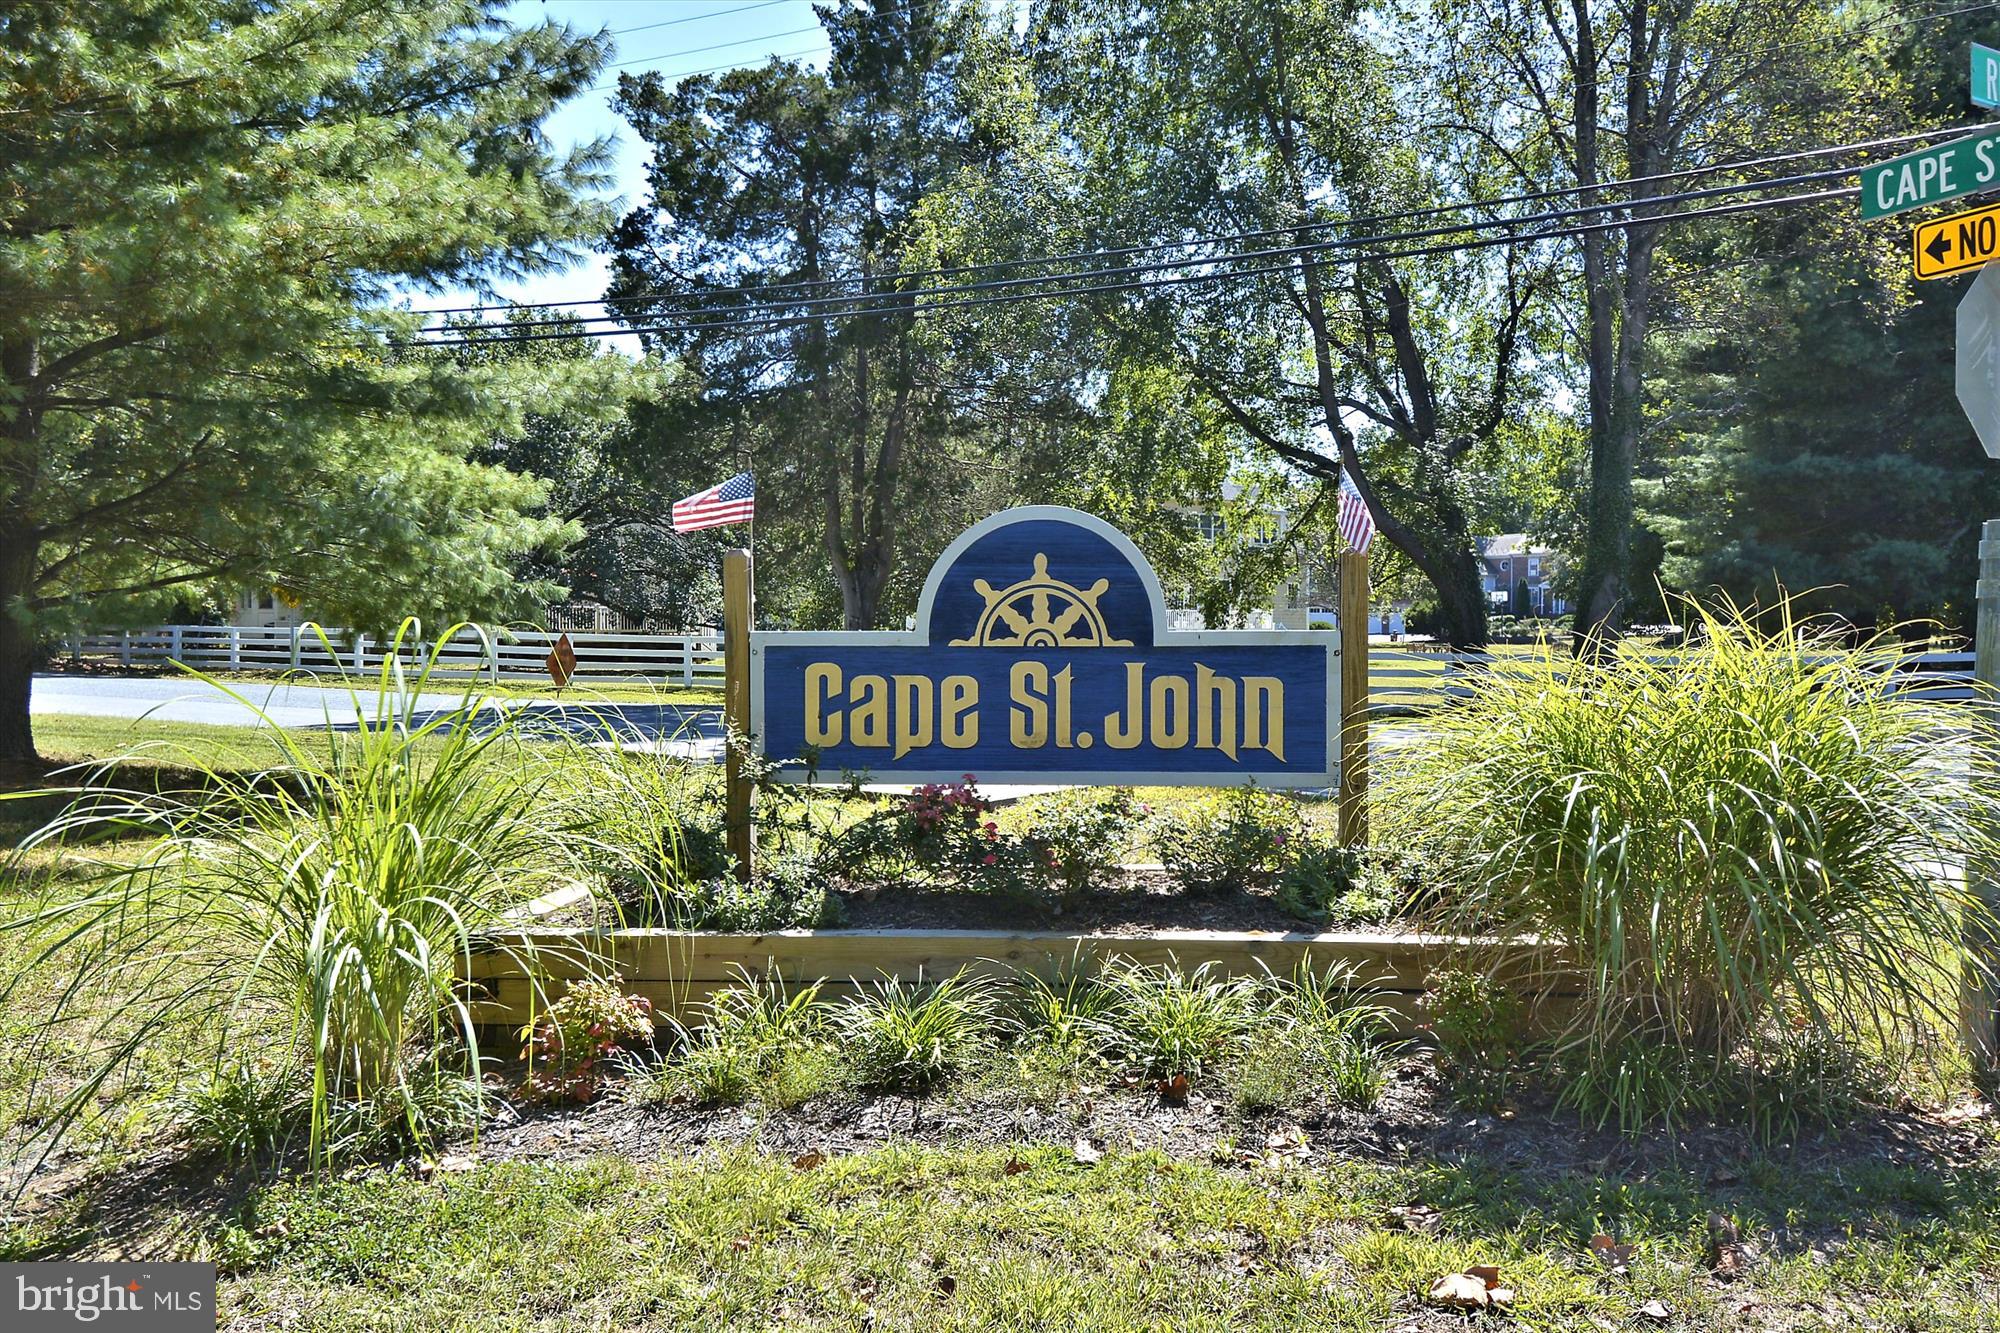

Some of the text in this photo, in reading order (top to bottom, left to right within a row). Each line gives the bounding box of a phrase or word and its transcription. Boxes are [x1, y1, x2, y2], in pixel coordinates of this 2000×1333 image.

[1877, 150, 1957, 210] CAPE
[1959, 216, 1996, 261] NO
[804, 661, 1286, 762] Cape St. John
